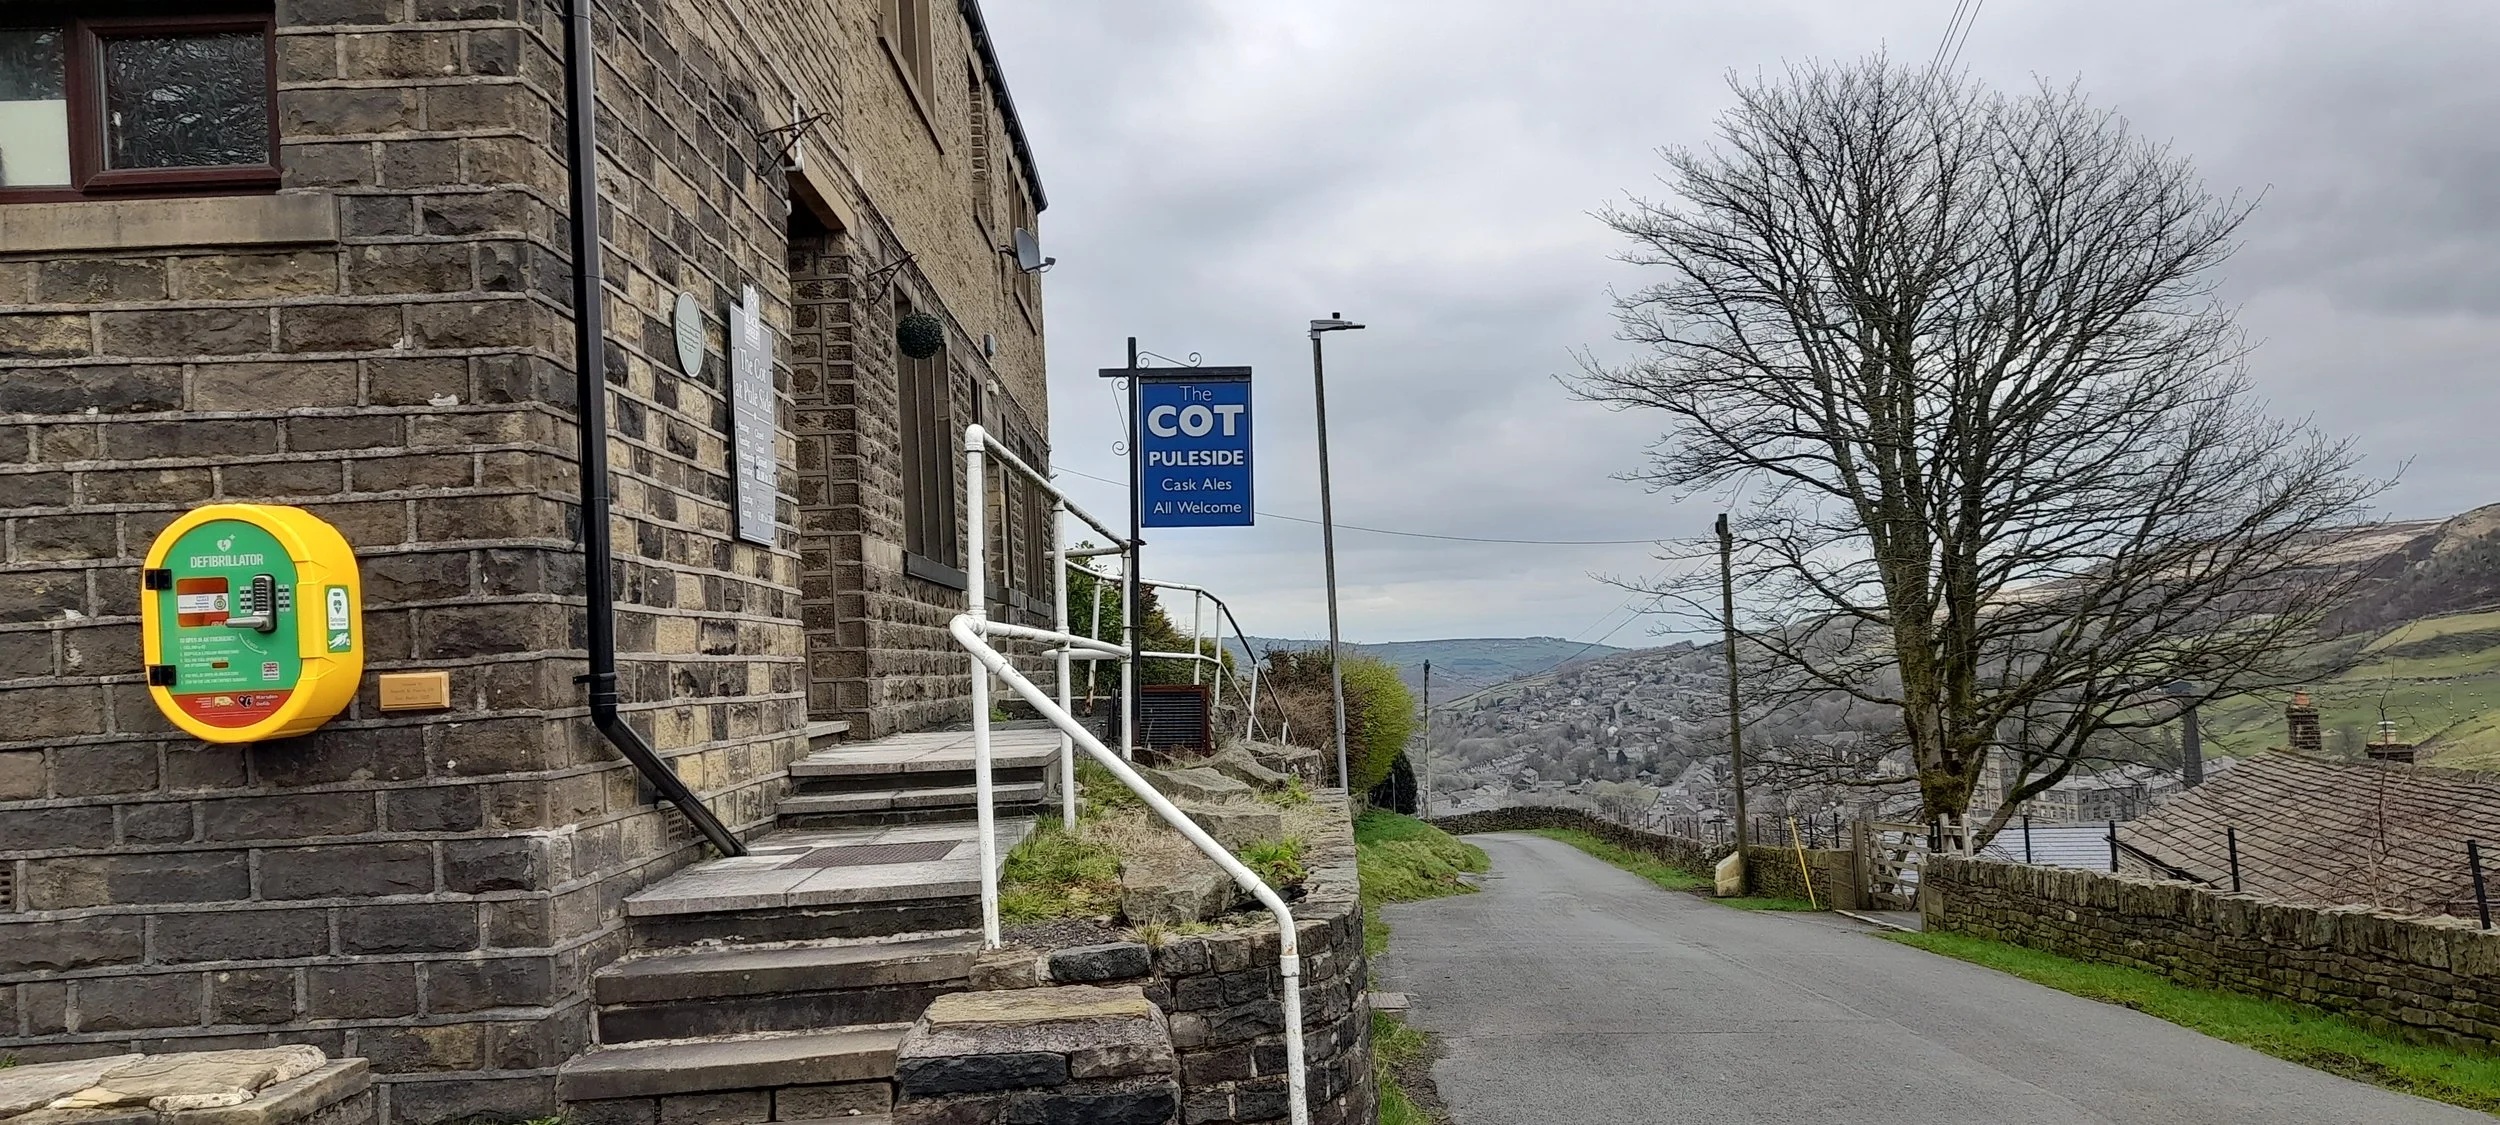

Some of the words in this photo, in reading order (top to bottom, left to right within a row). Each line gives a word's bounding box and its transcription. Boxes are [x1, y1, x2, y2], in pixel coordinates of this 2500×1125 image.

[740, 347, 753, 376] The
[754, 358, 767, 384] Cot
[735, 382, 743, 399] at
[759, 388, 772, 414] Side
[1179, 385, 1212, 401] The
[1147, 404, 1244, 438] COT
[1149, 450, 1244, 467] PULESIDE
[1161, 477, 1197, 491] Cask
[1202, 477, 1232, 491] Ales
[1153, 501, 1171, 514] All
[1177, 501, 1242, 514] Welcome
[190, 553, 264, 568] DEFIBRILLATOR
